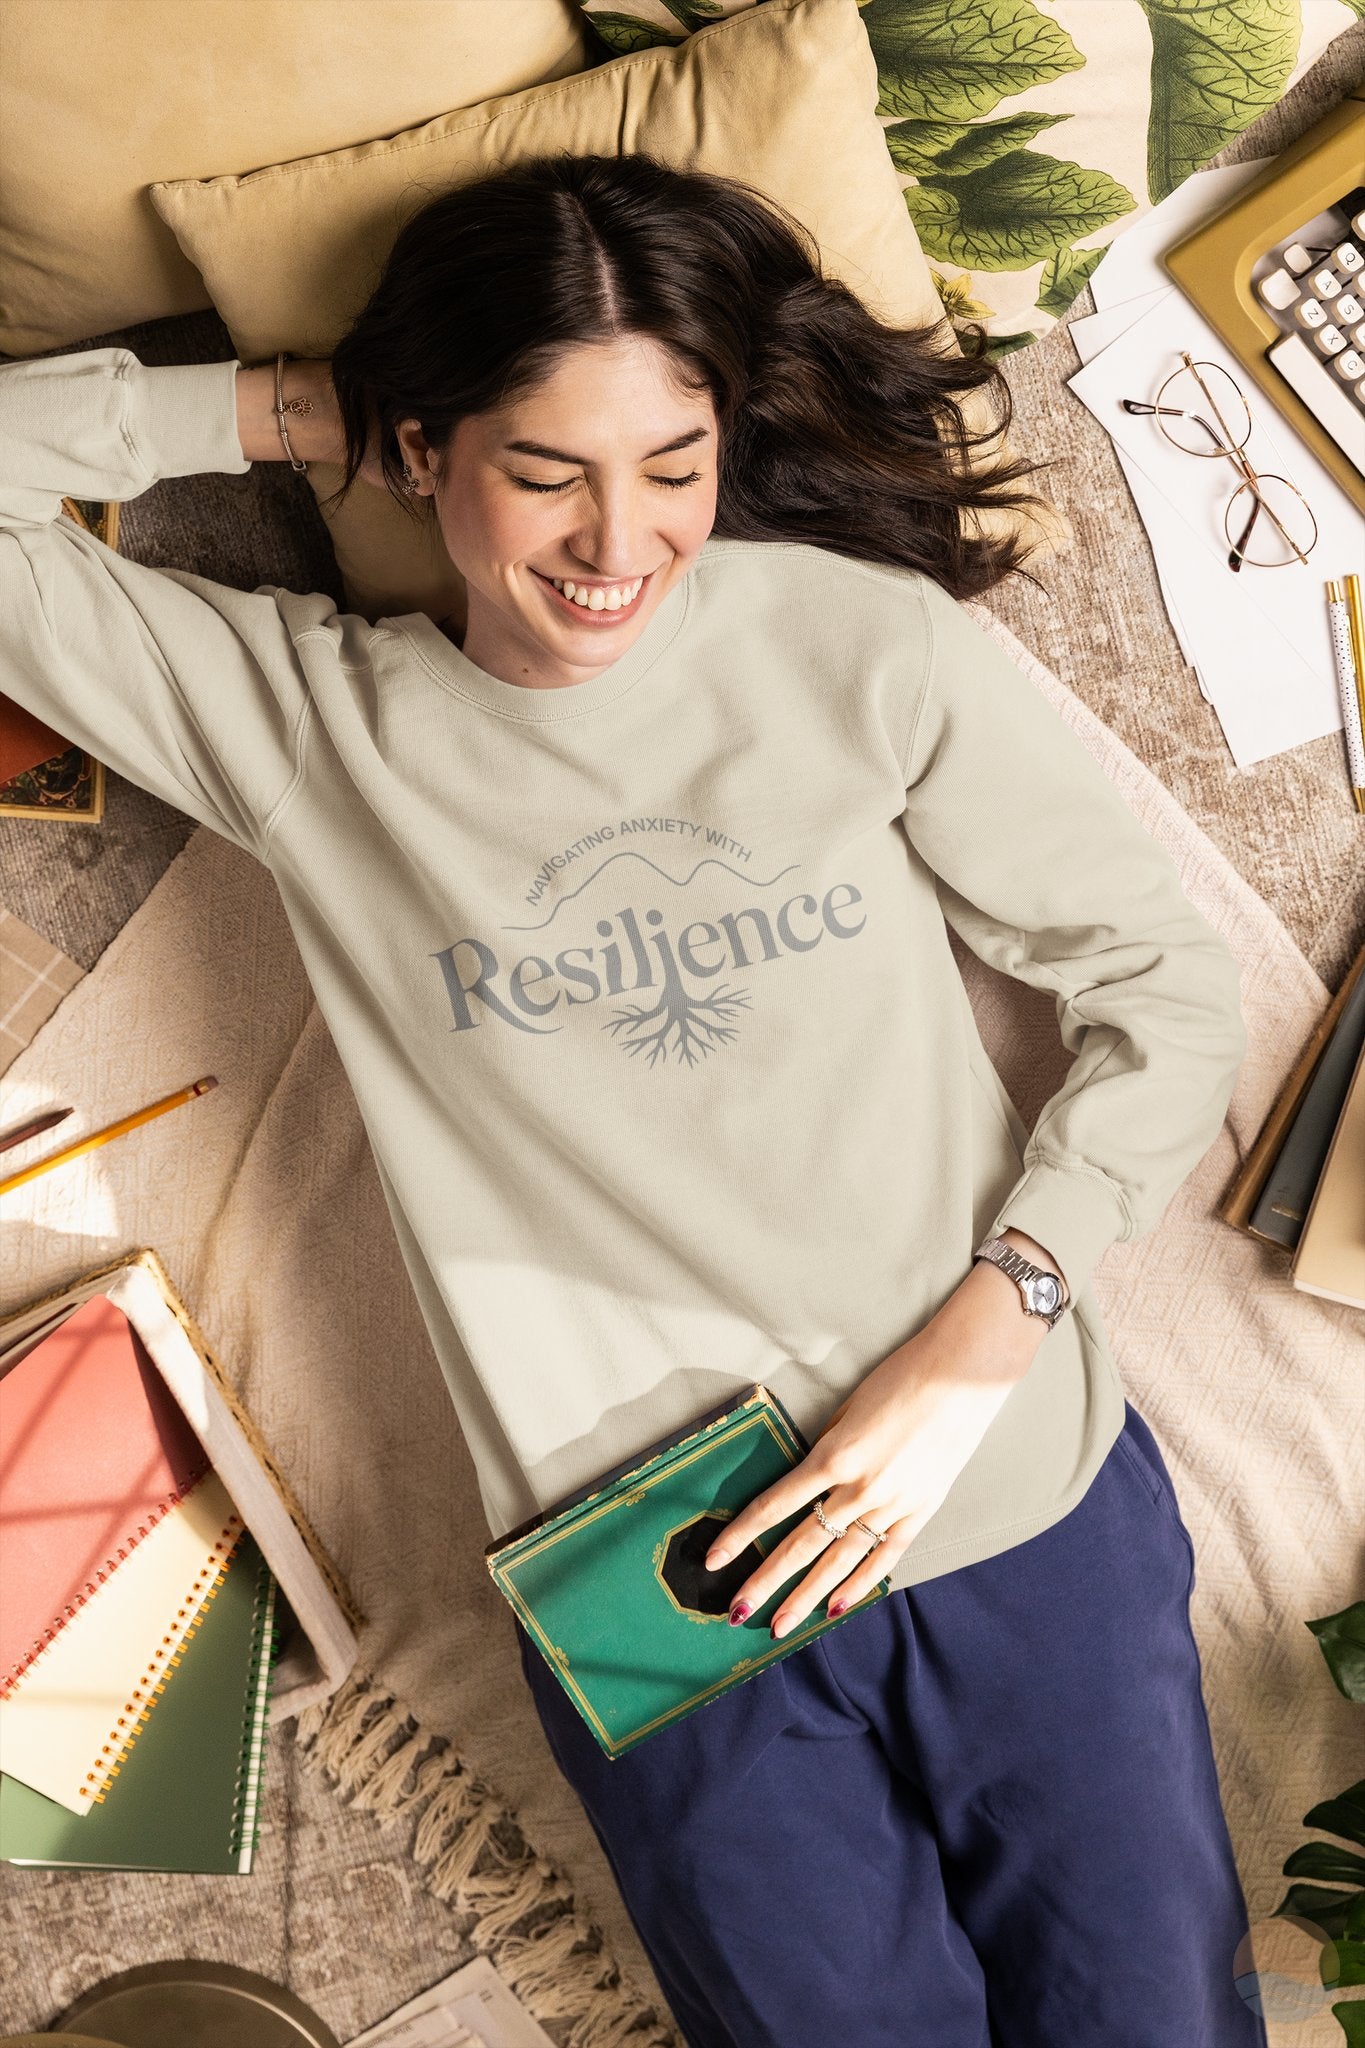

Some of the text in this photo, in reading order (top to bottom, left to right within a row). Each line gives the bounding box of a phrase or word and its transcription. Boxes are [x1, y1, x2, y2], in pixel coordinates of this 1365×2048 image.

[1345, 252, 1356, 266] Q
[1322, 280, 1332, 291] A
[1306, 307, 1319, 320] Z
[1343, 304, 1355, 315] S
[1327, 333, 1339, 345] X
[1347, 360, 1358, 371] C
[525, 817, 752, 907] NAVIGATING ANXIETY WITH
[429, 883, 868, 1035] Resilience
